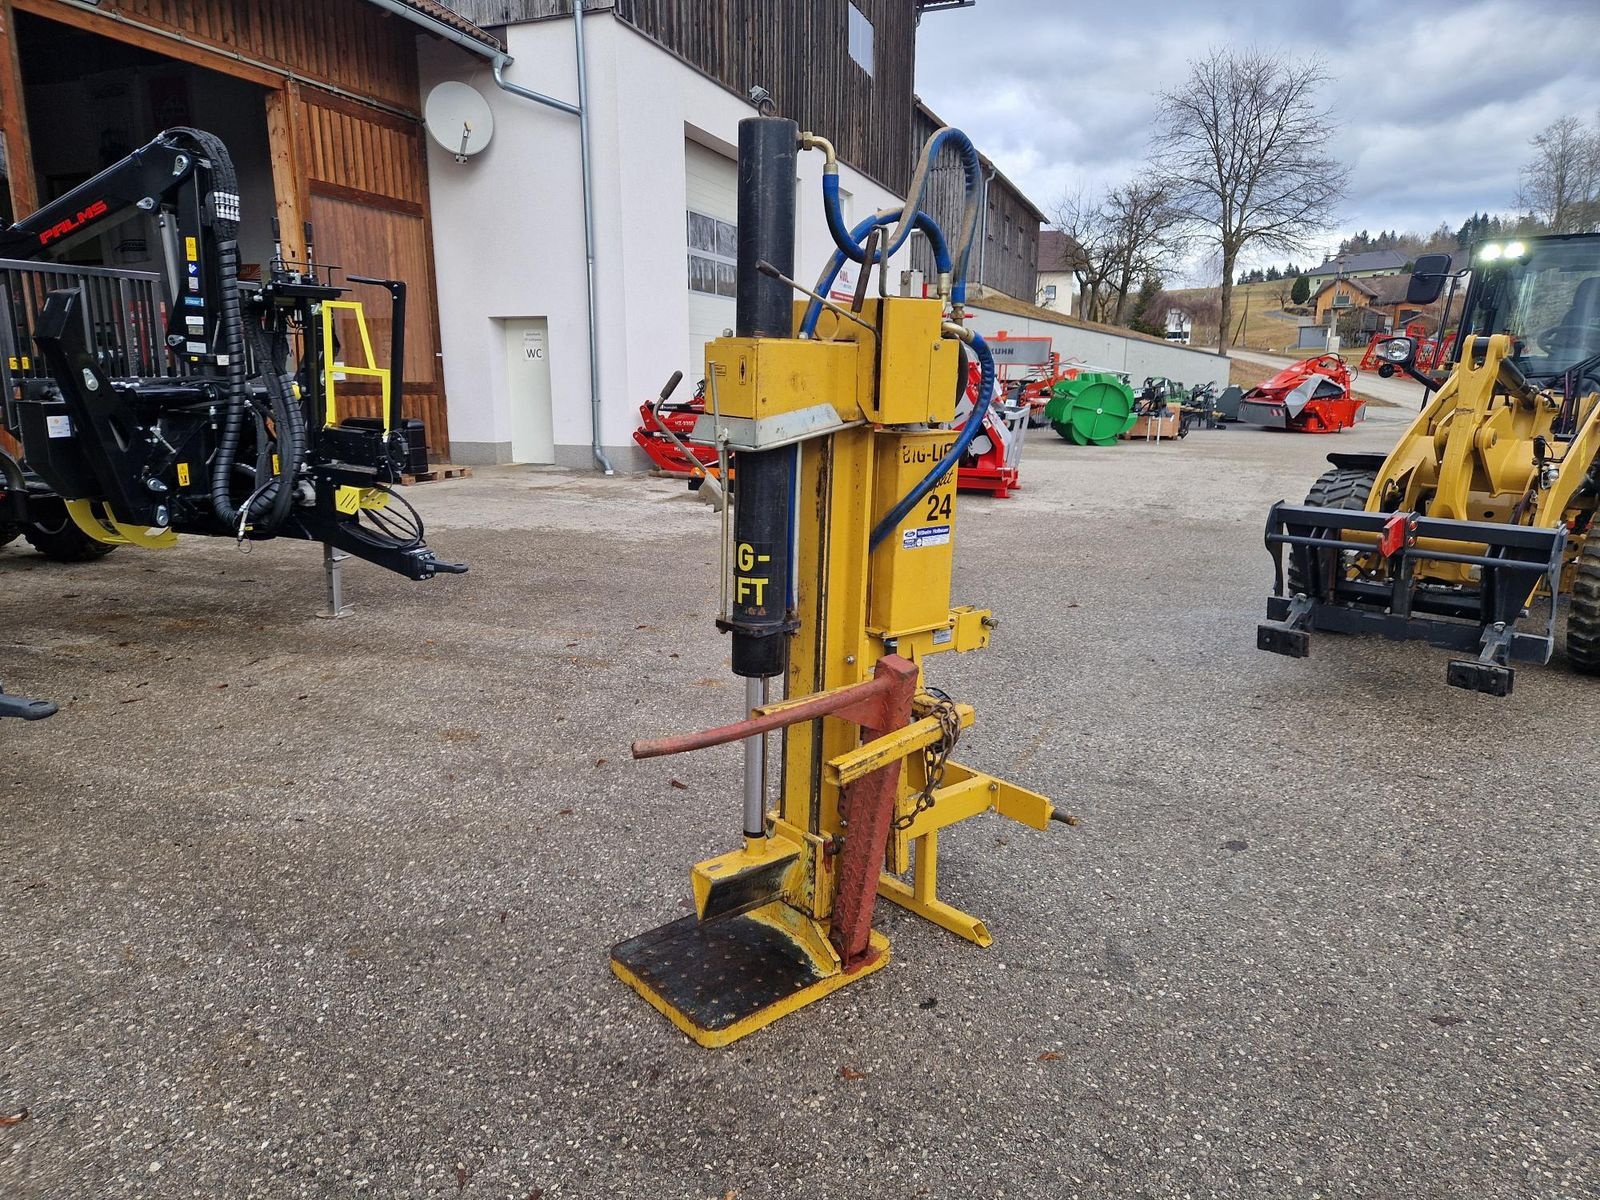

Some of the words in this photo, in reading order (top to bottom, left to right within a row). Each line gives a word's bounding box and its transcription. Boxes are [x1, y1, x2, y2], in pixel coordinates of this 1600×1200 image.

[39, 200, 107, 245] PALMS
[525, 348, 542, 358] WC
[926, 494, 952, 521] 24
